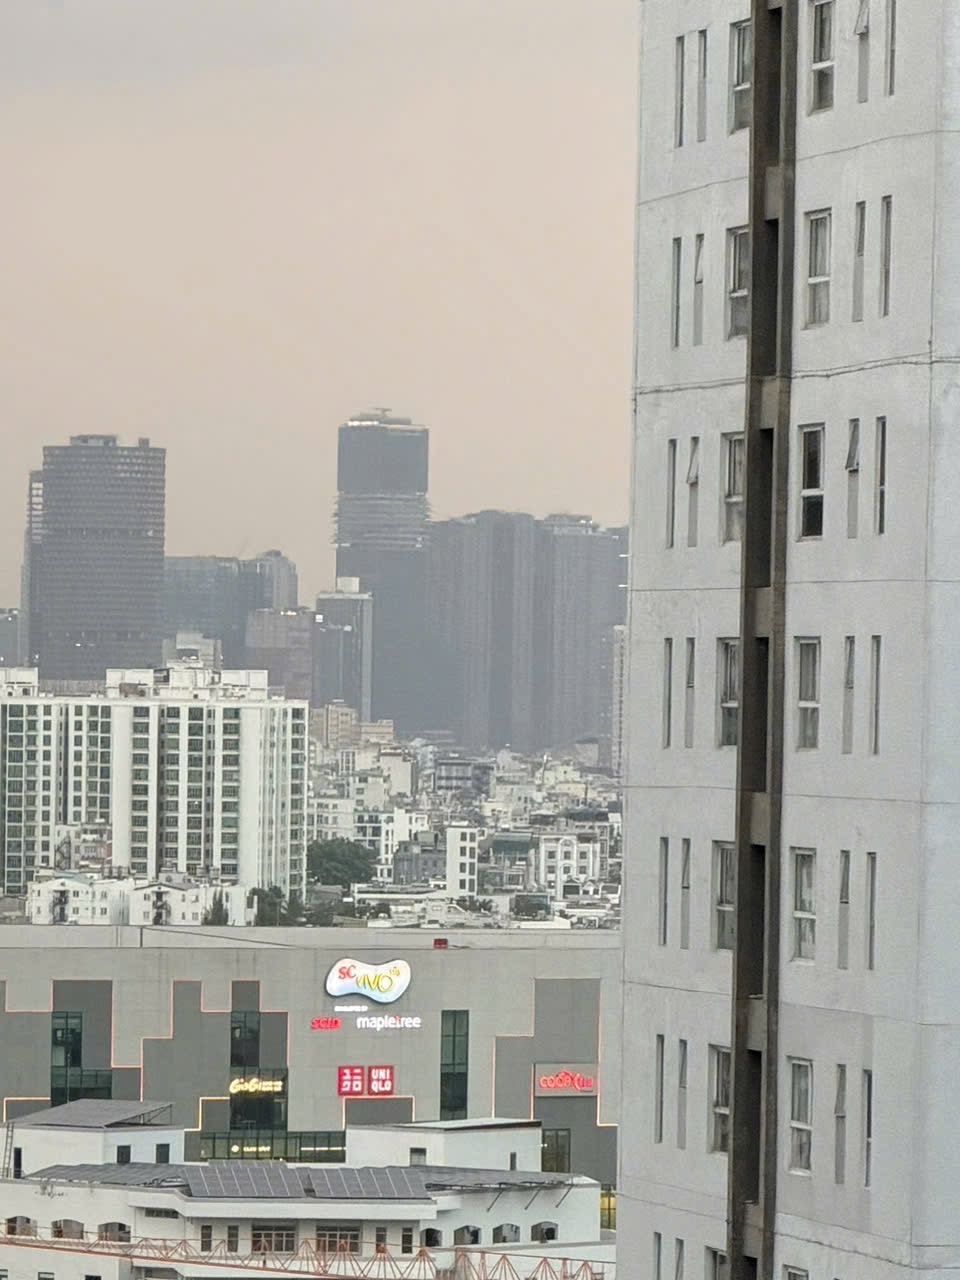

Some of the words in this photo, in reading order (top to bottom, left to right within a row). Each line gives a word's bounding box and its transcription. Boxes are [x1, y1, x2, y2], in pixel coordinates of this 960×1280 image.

[338, 965, 356, 979] SC
[356, 1015, 421, 1031] mapletree
[371, 1069, 390, 1080] UNI
[371, 1081, 392, 1093] QLO
